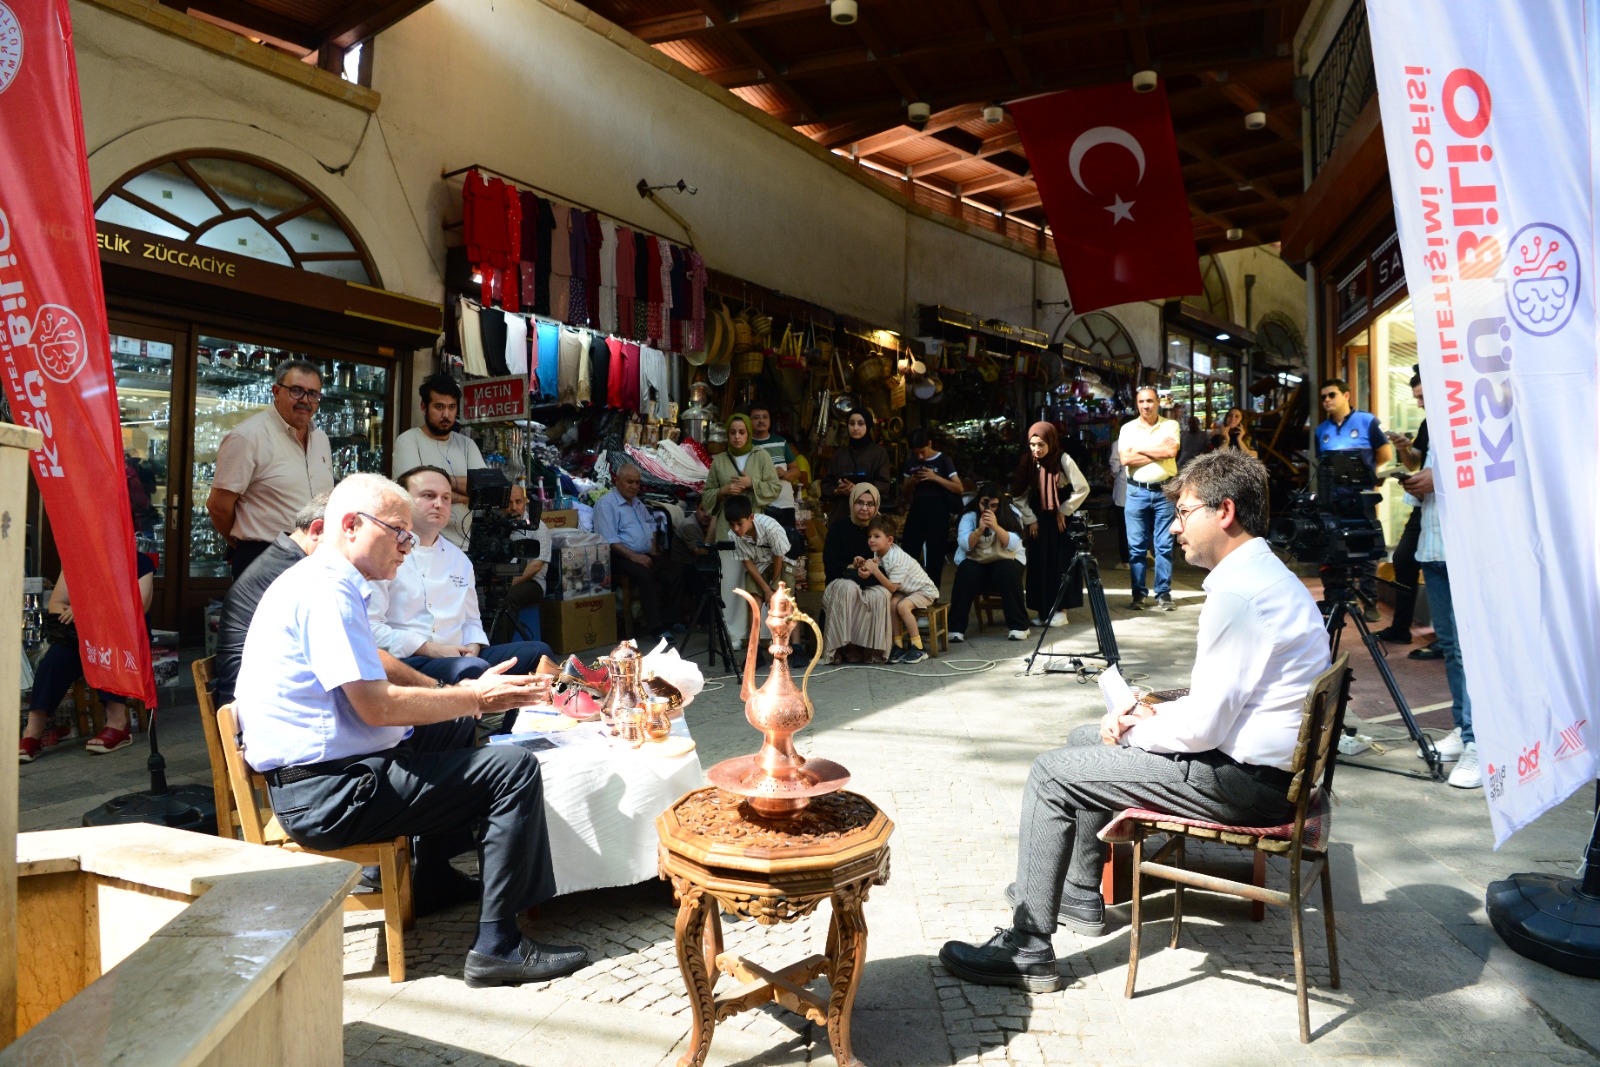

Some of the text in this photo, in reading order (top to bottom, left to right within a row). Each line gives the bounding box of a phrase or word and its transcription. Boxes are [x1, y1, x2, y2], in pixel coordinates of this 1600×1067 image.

[143, 243, 236, 277] ZÜCCACİYE
[1379, 251, 1402, 283] SA
[541, 516, 567, 527] olingen
